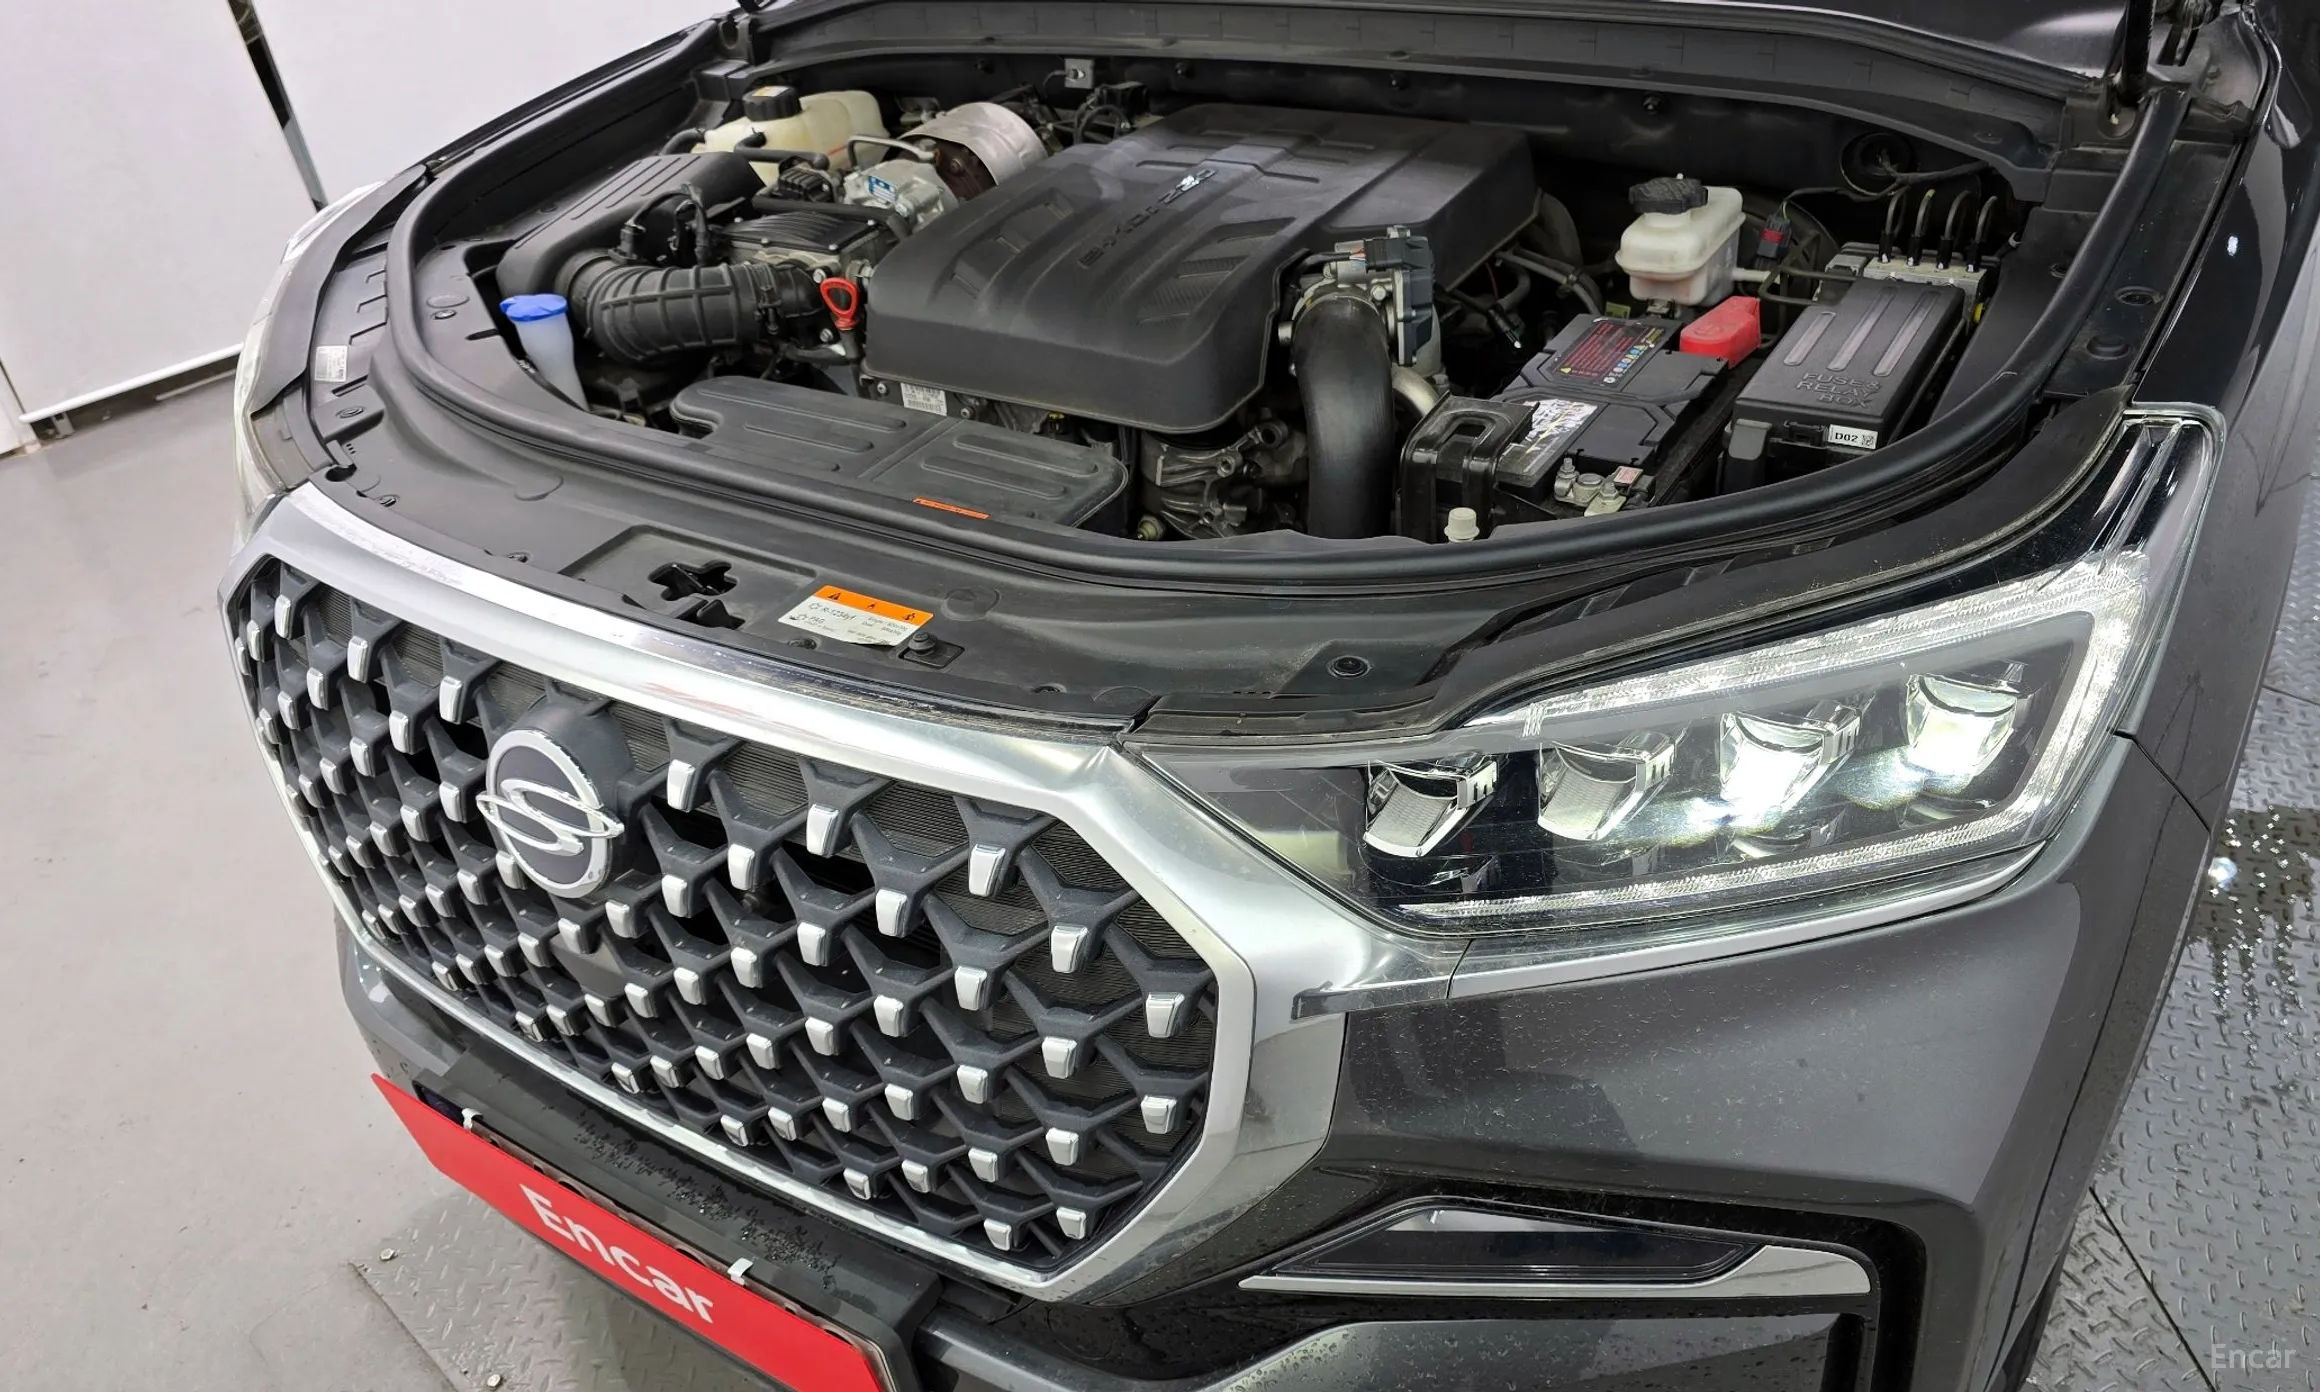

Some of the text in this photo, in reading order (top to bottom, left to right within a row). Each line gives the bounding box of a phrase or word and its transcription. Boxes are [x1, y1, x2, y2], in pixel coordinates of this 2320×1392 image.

[1796, 380, 1880, 399] RELAY
[1818, 393, 1870, 408] BOX
[1835, 432, 1858, 443] D02
[520, 1183, 714, 1324] Encar
